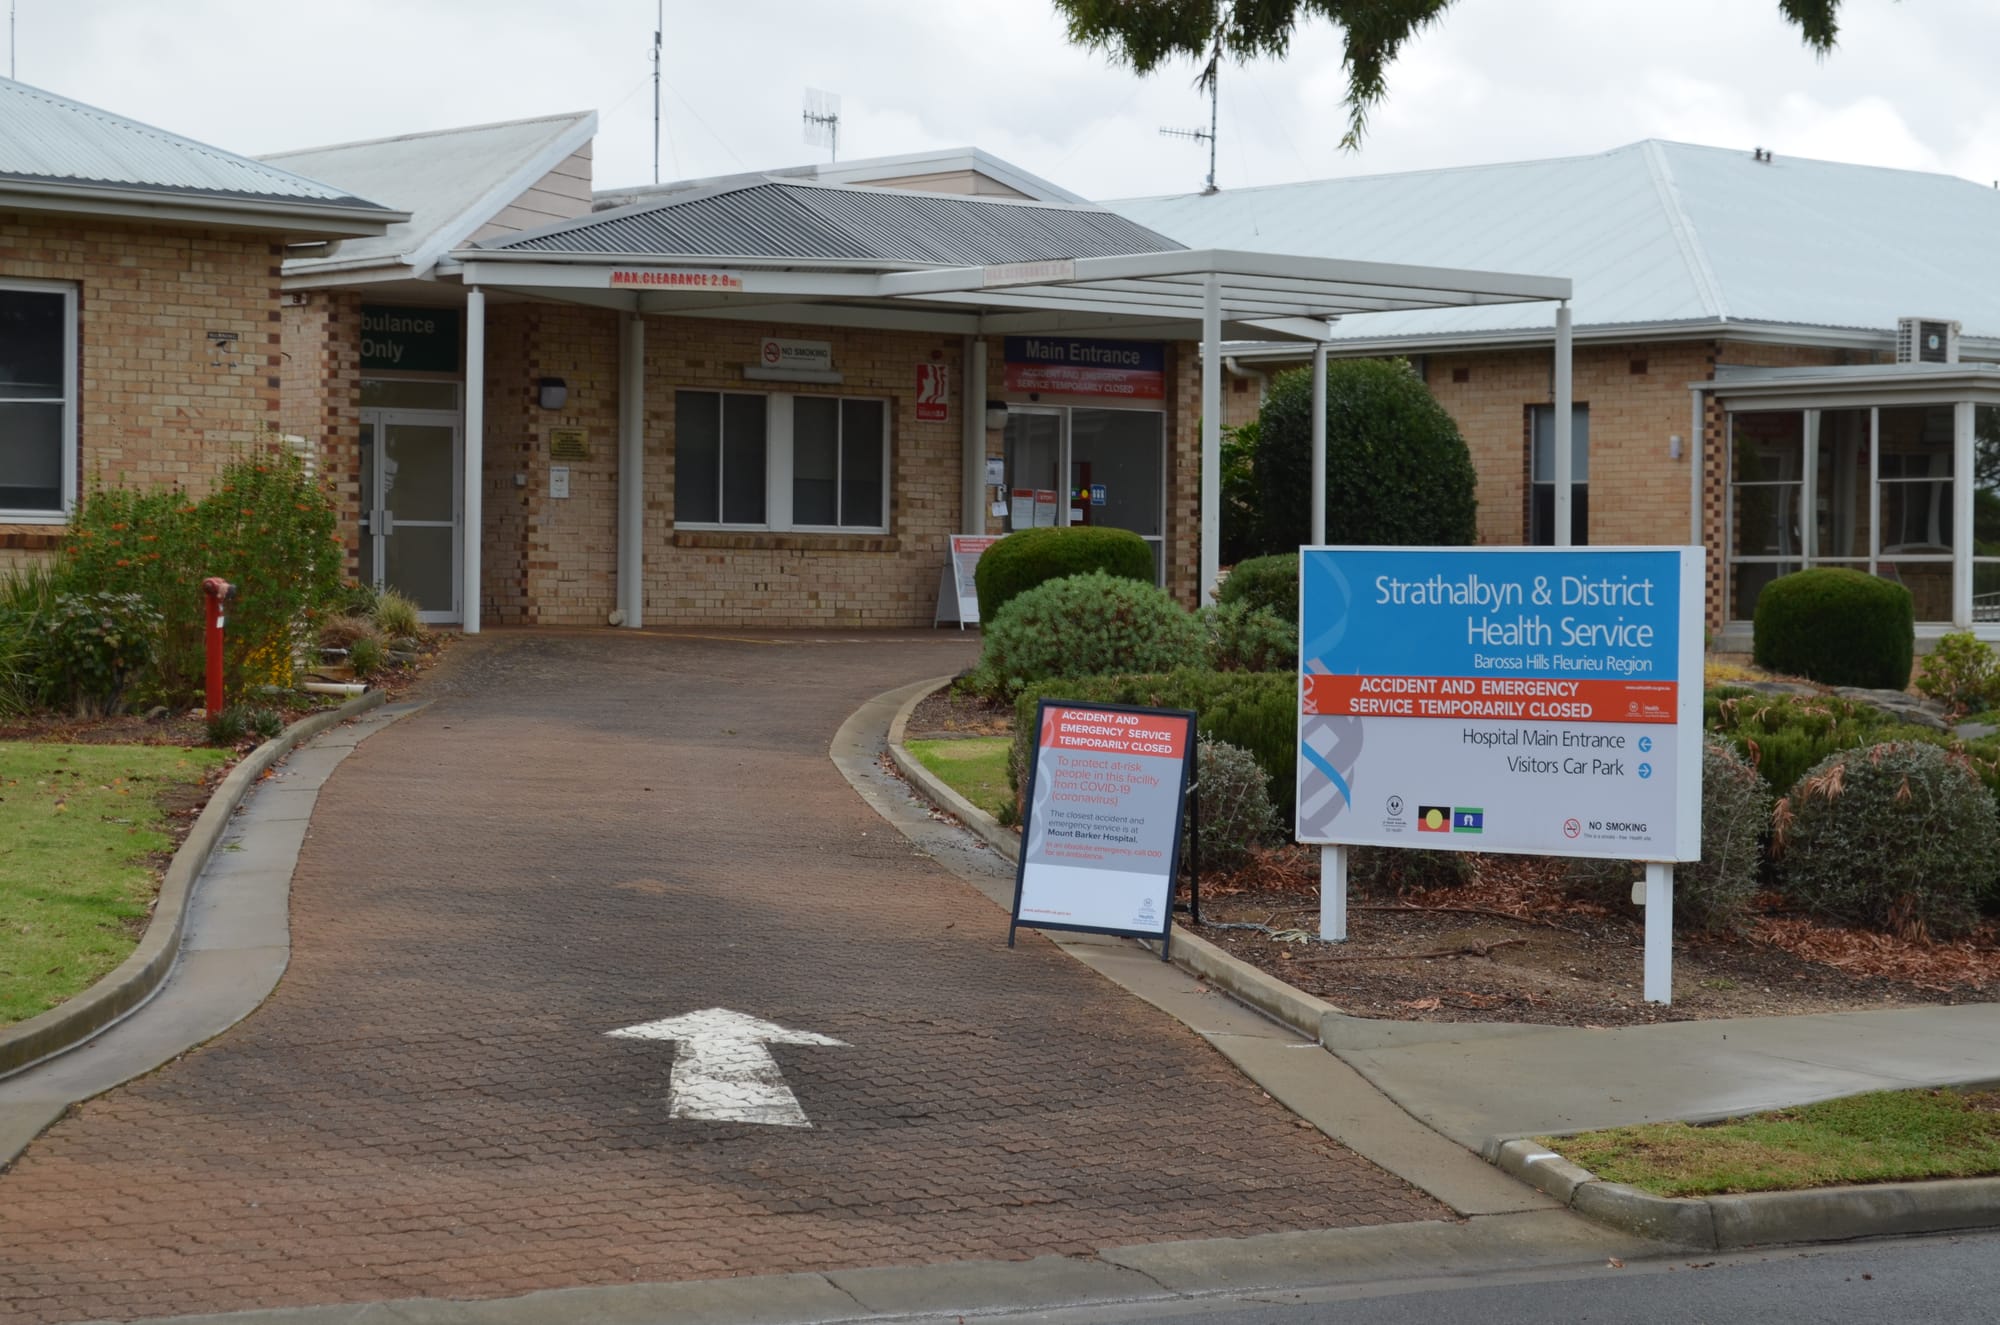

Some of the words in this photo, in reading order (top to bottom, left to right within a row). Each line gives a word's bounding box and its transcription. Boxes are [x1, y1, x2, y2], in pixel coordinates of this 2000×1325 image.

[361, 339, 404, 363] Only
[1026, 340, 1064, 360] Main
[1070, 343, 1141, 365] Entrance
[1104, 384, 1134, 394] CLOSED
[1375, 574, 1523, 612] Strathalbyn
[1531, 576, 1552, 606] &
[1562, 576, 1654, 607] District
[1468, 616, 1552, 646] Health
[1561, 617, 1654, 648] Service
[1474, 654, 1523, 670] Barossa
[1526, 654, 1550, 670] Hills
[1553, 655, 1604, 671] Fleurieu
[1606, 656, 1652, 675] Region
[1360, 678, 1438, 694] ACCIDENT
[1440, 680, 1475, 694] AND
[1482, 681, 1578, 697] EMERGENCY
[1350, 698, 1412, 715] SERVICE
[1418, 700, 1525, 717] TEMPORARILY
[1528, 702, 1592, 718] CLOSED
[1062, 711, 1114, 723] ACCIDENT
[1116, 716, 1139, 725] AND
[1060, 723, 1124, 736] EMERGENCY
[1128, 729, 1172, 741] SERVICE
[1462, 728, 1518, 749] Hospital
[1523, 730, 1558, 747] Main
[1562, 732, 1626, 750] Entrance
[1060, 736, 1129, 750] TEMPORARILY
[1131, 742, 1172, 754] CLOSED
[1058, 755, 1068, 766] To
[1072, 758, 1108, 770] protect
[1110, 762, 1142, 772] at-risk
[1507, 756, 1559, 774] Visitors
[1563, 758, 1588, 774] Car
[1592, 759, 1624, 776] Park
[1054, 778, 1077, 790] from
[1080, 781, 1131, 794] COVID-19
[1055, 768, 1091, 780] people
[1106, 772, 1124, 782] this
[1127, 774, 1160, 788] facility
[1052, 790, 1119, 807] (coronavirus)
[1050, 809, 1064, 818] The
[1066, 811, 1093, 820] closest
[1094, 814, 1128, 823] accident
[1129, 816, 1144, 824] and
[1048, 820, 1091, 830] emergency
[1093, 824, 1120, 832] service
[1588, 821, 1602, 832] NO
[1606, 822, 1648, 834] SMOKING
[1048, 828, 1073, 838] Mount
[1074, 831, 1100, 840] Barker
[1102, 834, 1138, 844] Hospital.
